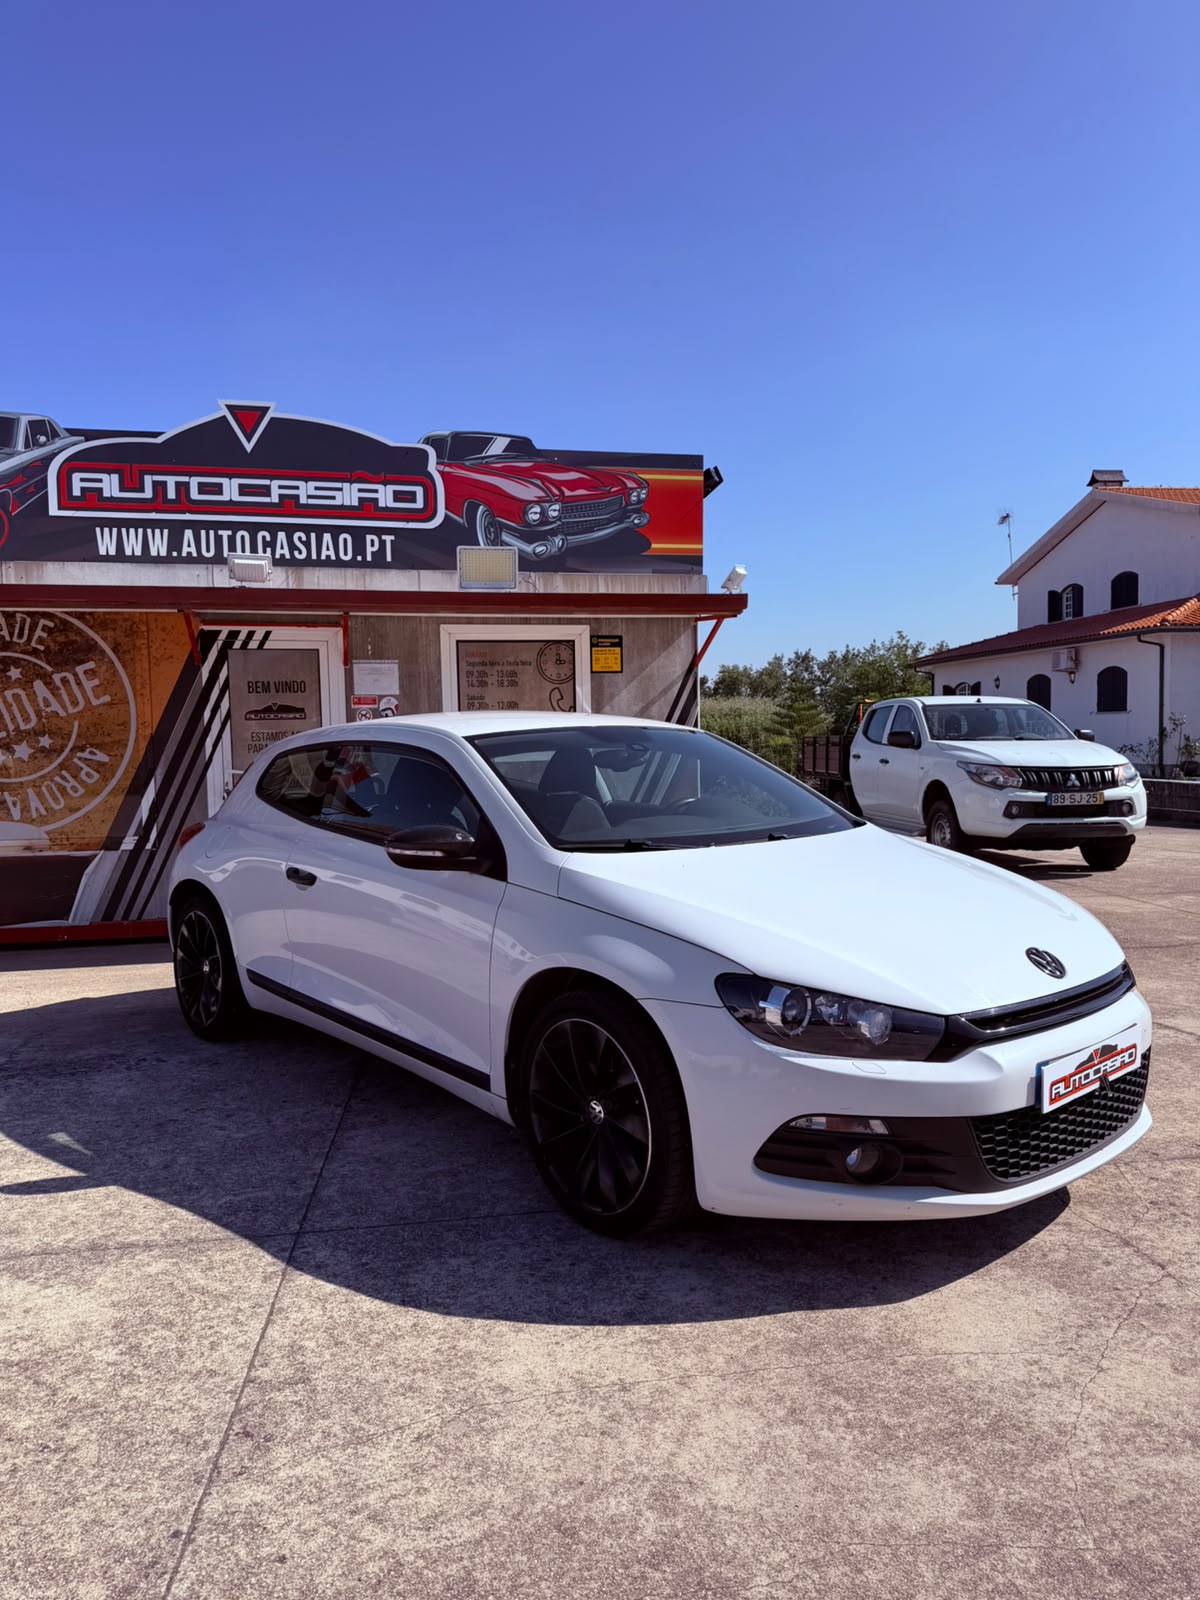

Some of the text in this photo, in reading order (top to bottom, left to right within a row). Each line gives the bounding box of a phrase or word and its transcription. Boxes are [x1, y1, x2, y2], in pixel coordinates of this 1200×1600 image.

[95, 526, 395, 562] WWW.AUTOCASIAO.PT
[0, 661, 111, 738] IDADE
[247, 680, 306, 694] BEM VINDO
